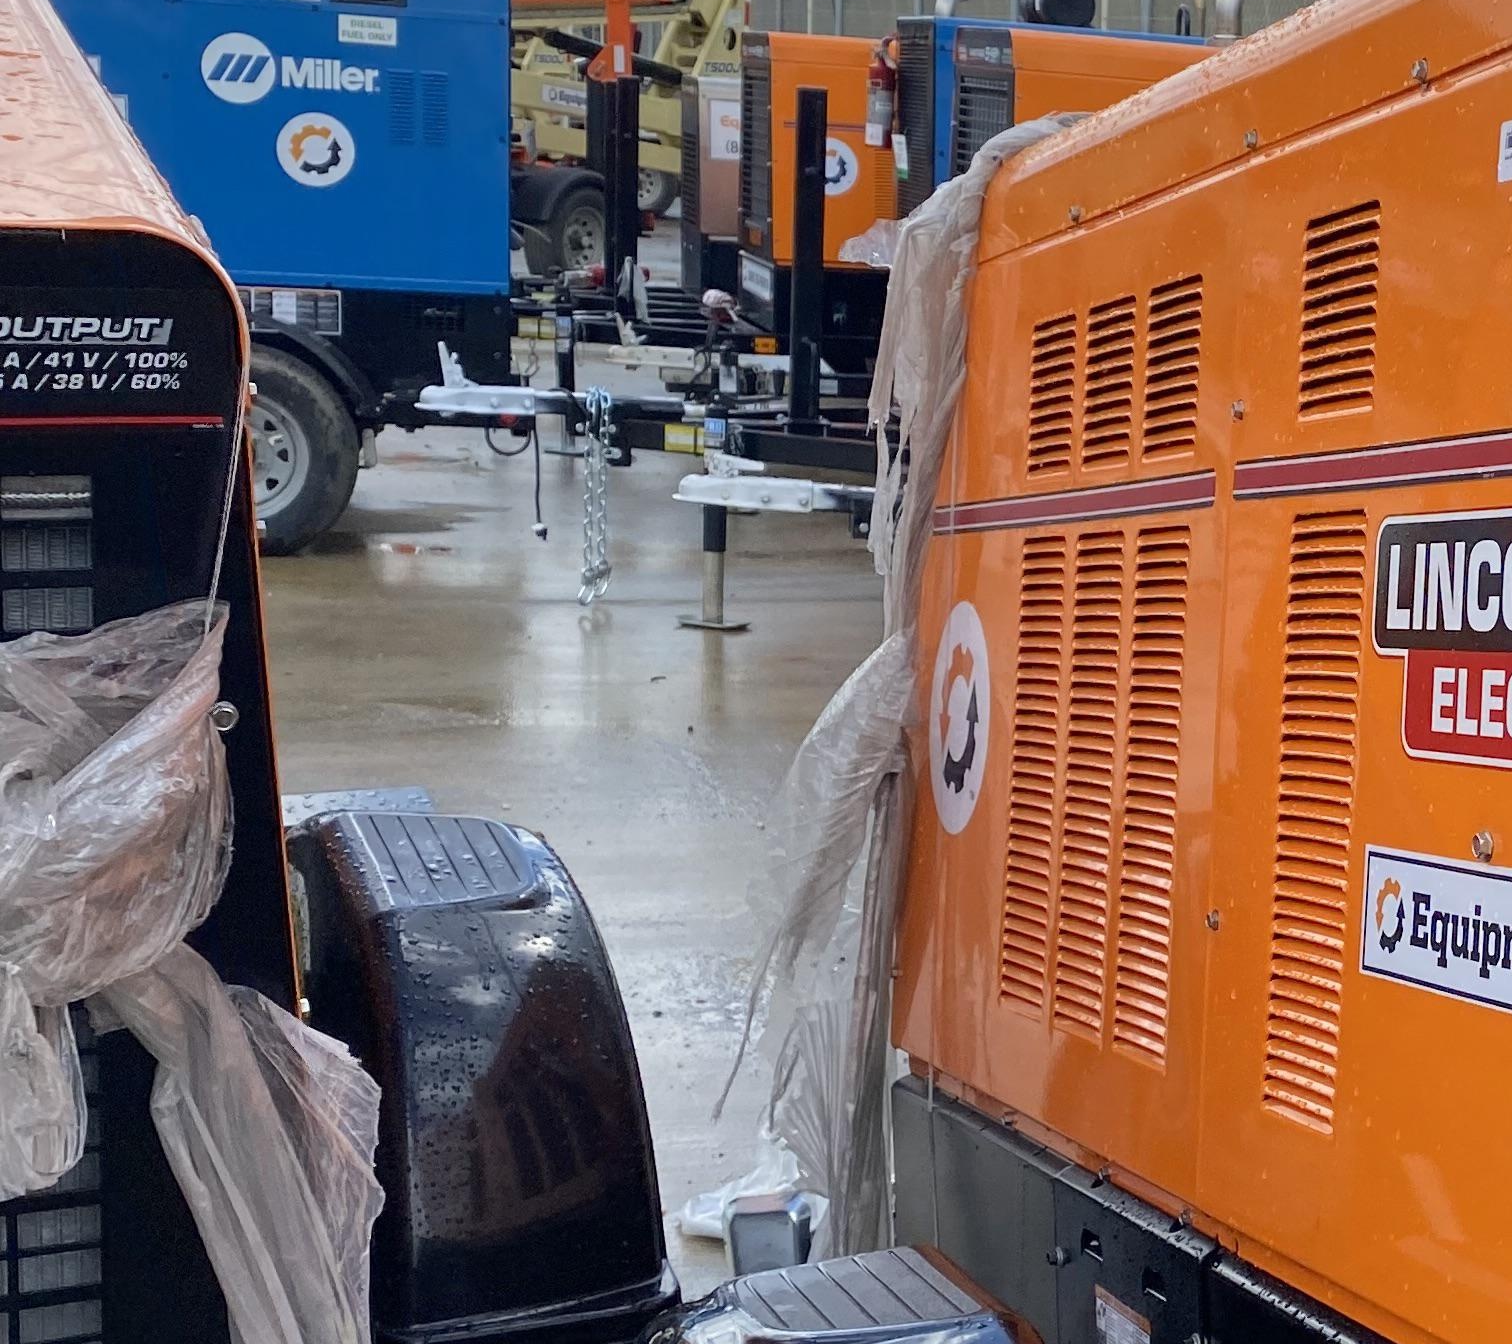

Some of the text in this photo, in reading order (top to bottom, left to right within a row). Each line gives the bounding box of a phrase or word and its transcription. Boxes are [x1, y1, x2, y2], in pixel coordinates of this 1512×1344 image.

[349, 19, 384, 30] DIESEL
[341, 29, 393, 42] FUEL ONLY
[281, 56, 379, 93] Miller
[3, 351, 20, 369] A
[44, 351, 75, 369] 41
[83, 352, 100, 369] V
[124, 352, 188, 370] 100%
[11, 373, 29, 390] A
[52, 373, 85, 391] 38
[91, 373, 109, 390] V
[130, 372, 181, 391] 60%
